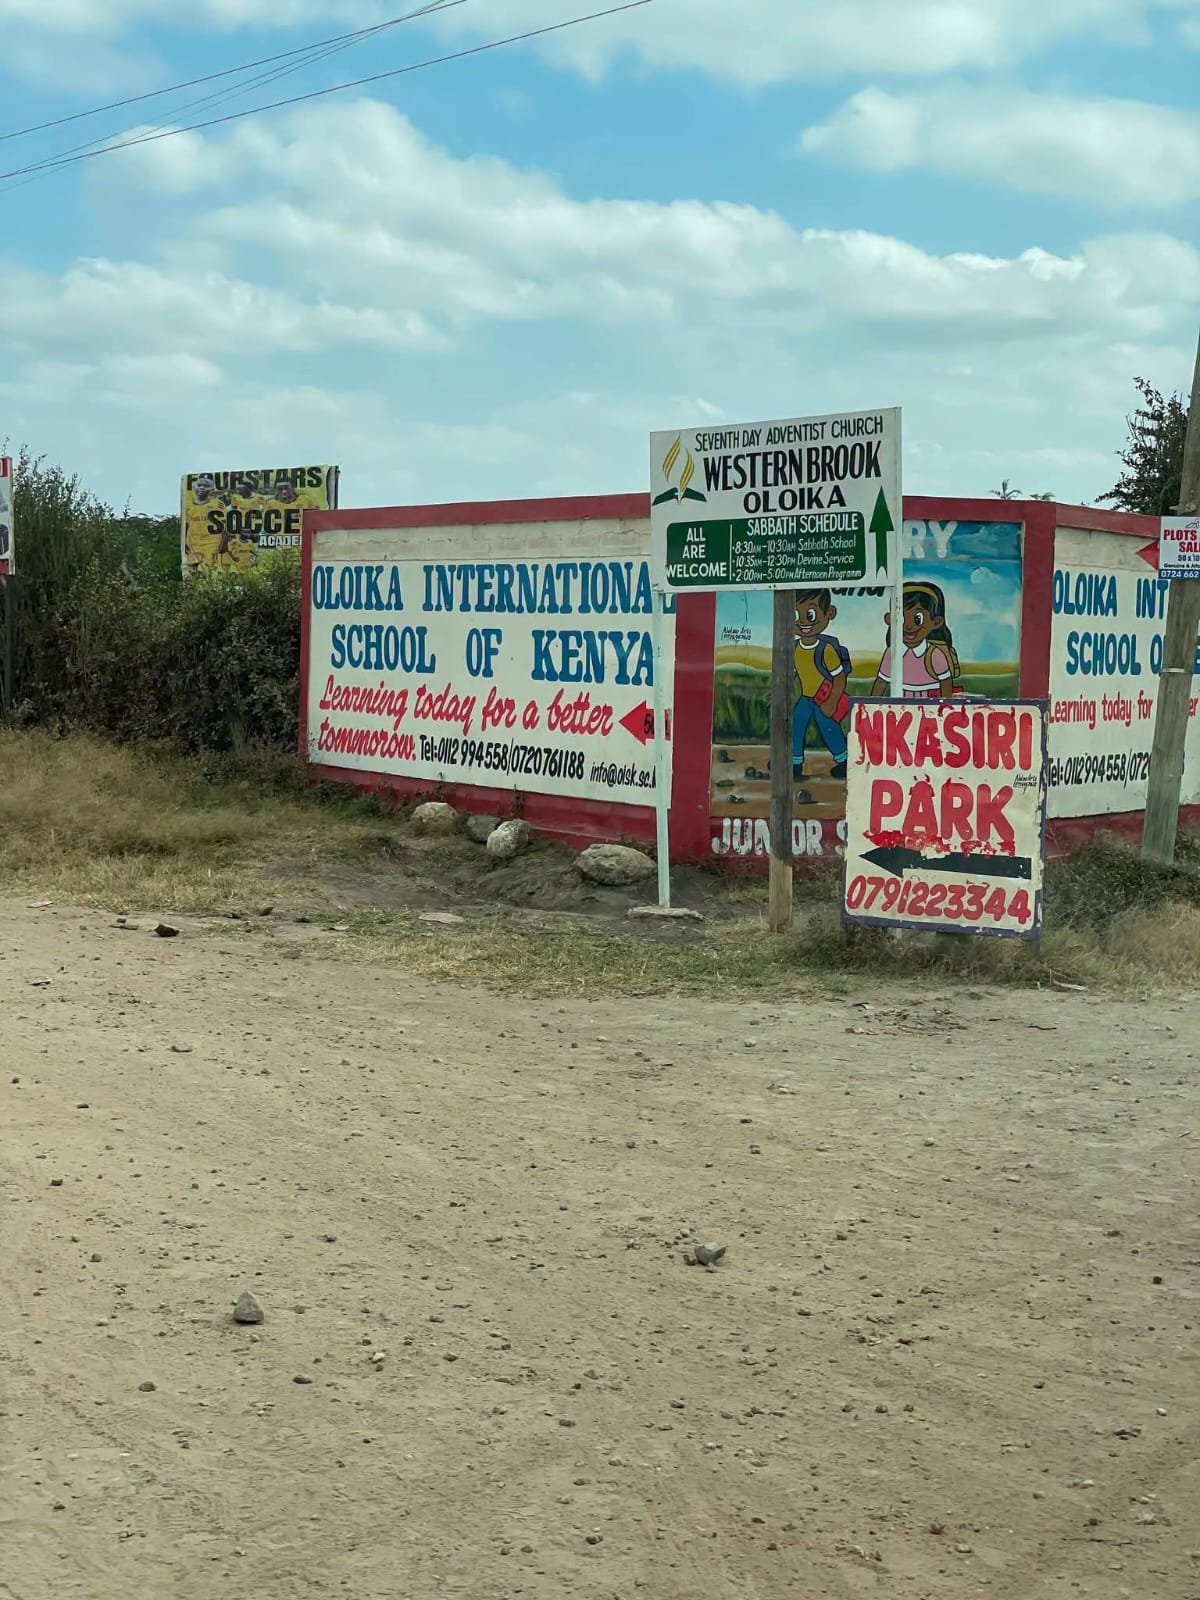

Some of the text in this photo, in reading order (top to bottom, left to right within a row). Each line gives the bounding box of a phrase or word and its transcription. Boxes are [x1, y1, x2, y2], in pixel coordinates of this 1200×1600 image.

[694, 416, 883, 452] SEVENTH DAY ADVENTIST CHURCH
[743, 485, 847, 514] OLOIKA
[207, 508, 303, 535] SOCCE
[686, 527, 706, 542] ALL
[747, 513, 859, 536] SABBATH SCHEDULE
[1163, 529, 1198, 541] PLOTS
[259, 535, 302, 547] ACADE
[682, 544, 706, 559] ARE
[798, 538, 829, 552] Sabbath
[829, 534, 857, 549] School
[1178, 541, 1200, 553] SAL
[665, 562, 727, 578] WELCOME
[797, 553, 823, 566] Devine
[823, 552, 855, 564] Service
[312, 565, 404, 611] OLOIKA
[1160, 570, 1182, 578] 0724
[1052, 569, 1118, 617] OLOIKA
[331, 624, 654, 686] SCHOOL OF KENYA
[1066, 631, 1142, 676] SCHOOL
[319, 674, 409, 732] Learning
[413, 682, 476, 737] today
[480, 686, 517, 732] for
[522, 699, 540, 731] a
[547, 688, 614, 737] better
[1048, 693, 1097, 730] Learning
[1101, 691, 1132, 727] today
[1137, 689, 1153, 720] for
[855, 708, 1033, 771] NKASIRI
[869, 779, 1015, 842] PARK
[711, 817, 823, 856] JUNOR
[846, 875, 1031, 925] 0791223344
